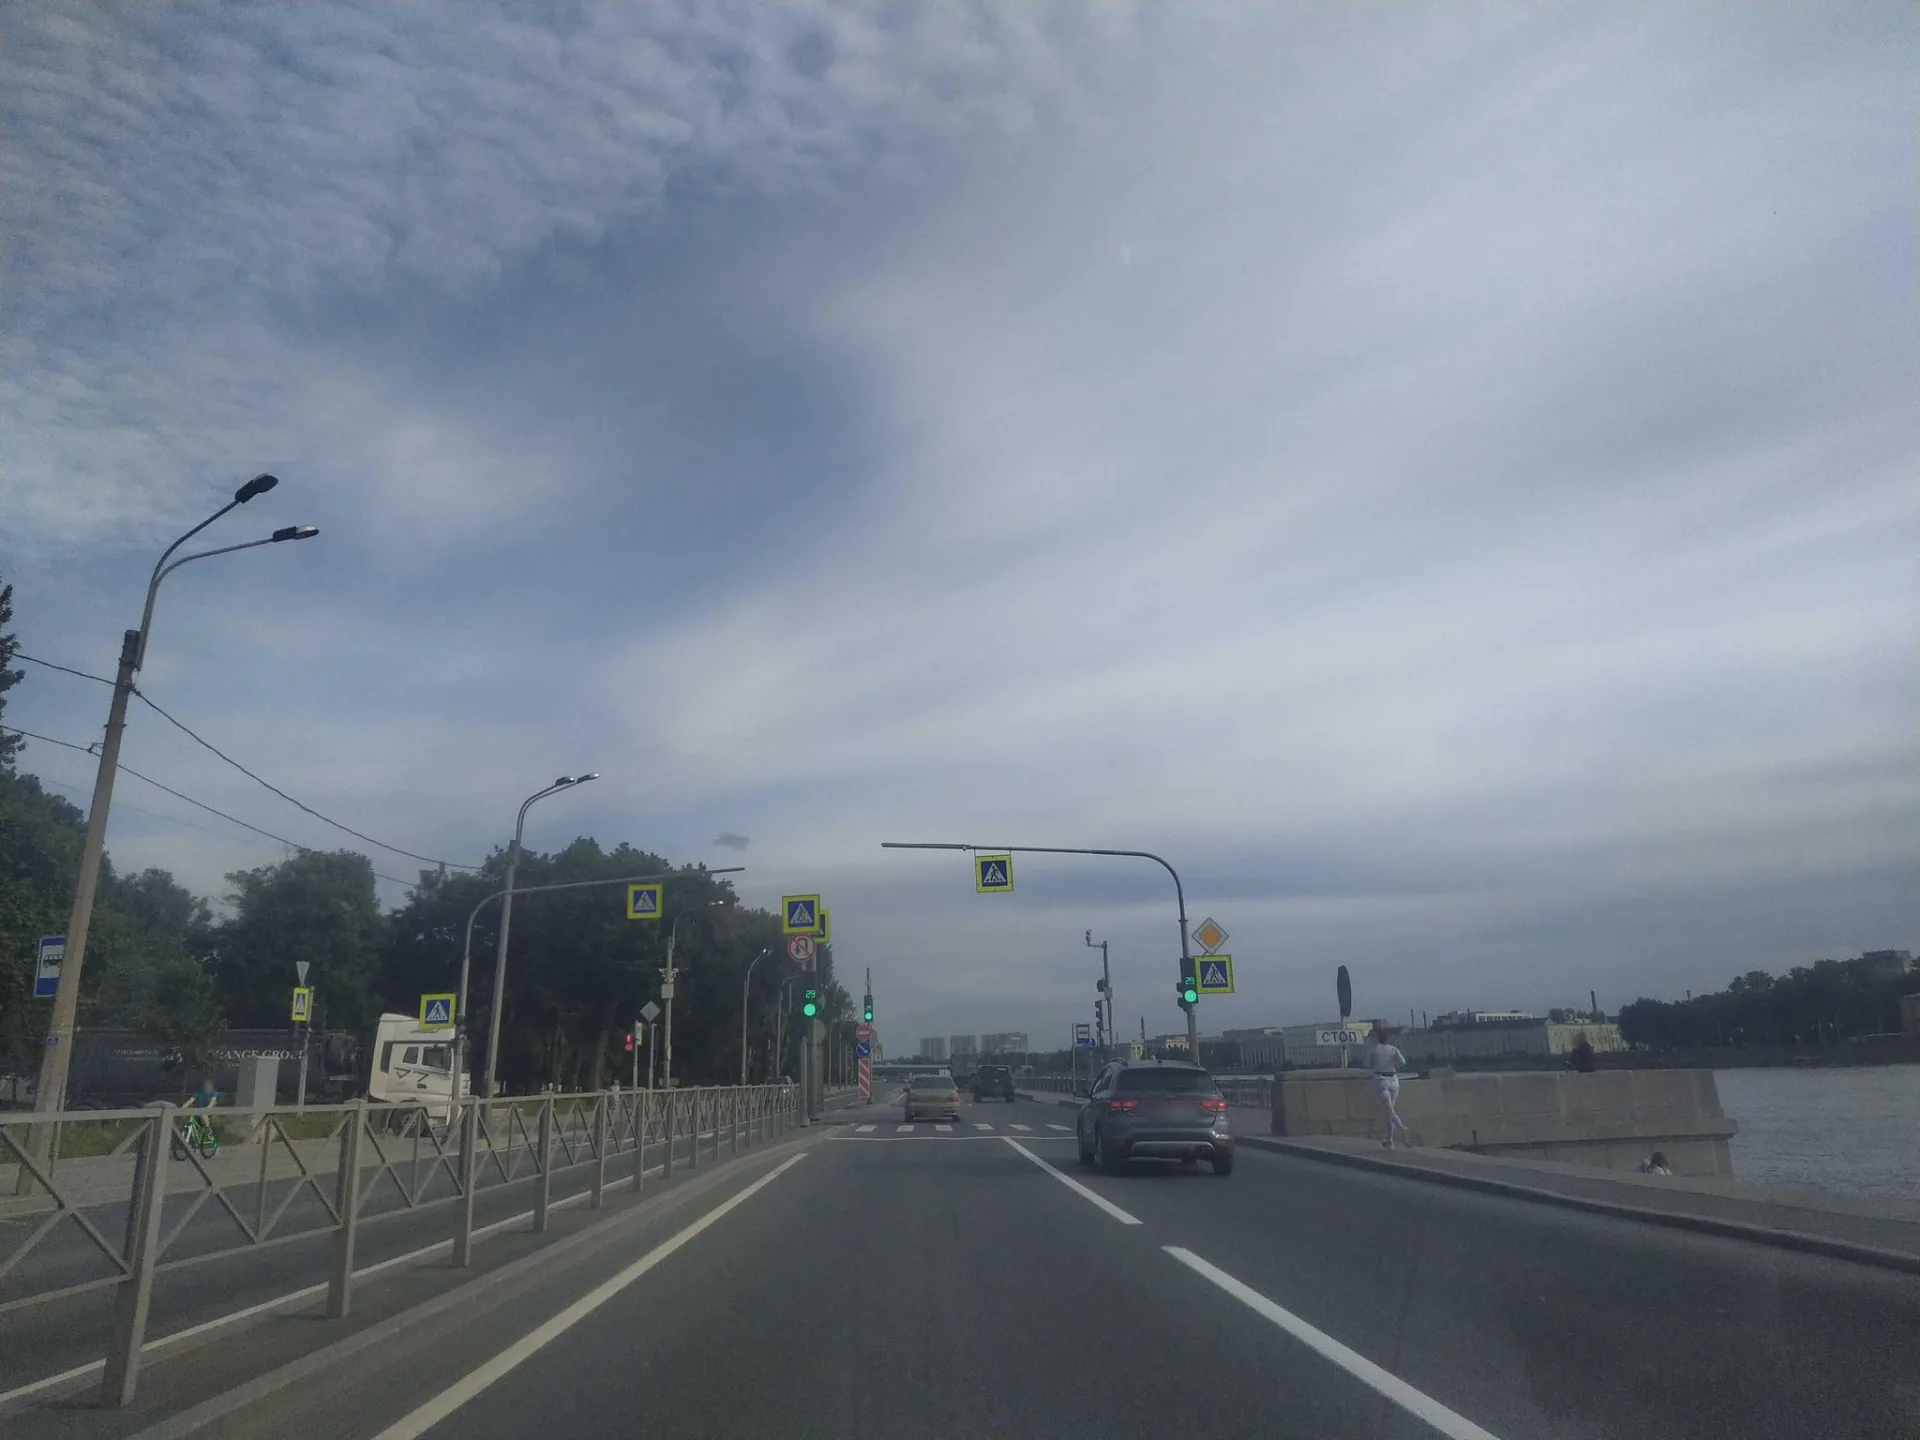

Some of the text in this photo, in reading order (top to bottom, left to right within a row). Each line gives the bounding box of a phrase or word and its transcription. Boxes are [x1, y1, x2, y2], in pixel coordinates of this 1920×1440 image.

[1185, 976, 1195, 985] 29
[805, 989, 816, 998] 29
[1321, 1031, 1357, 1043] СТОП
[206, 1049, 259, 1060] ANGE
